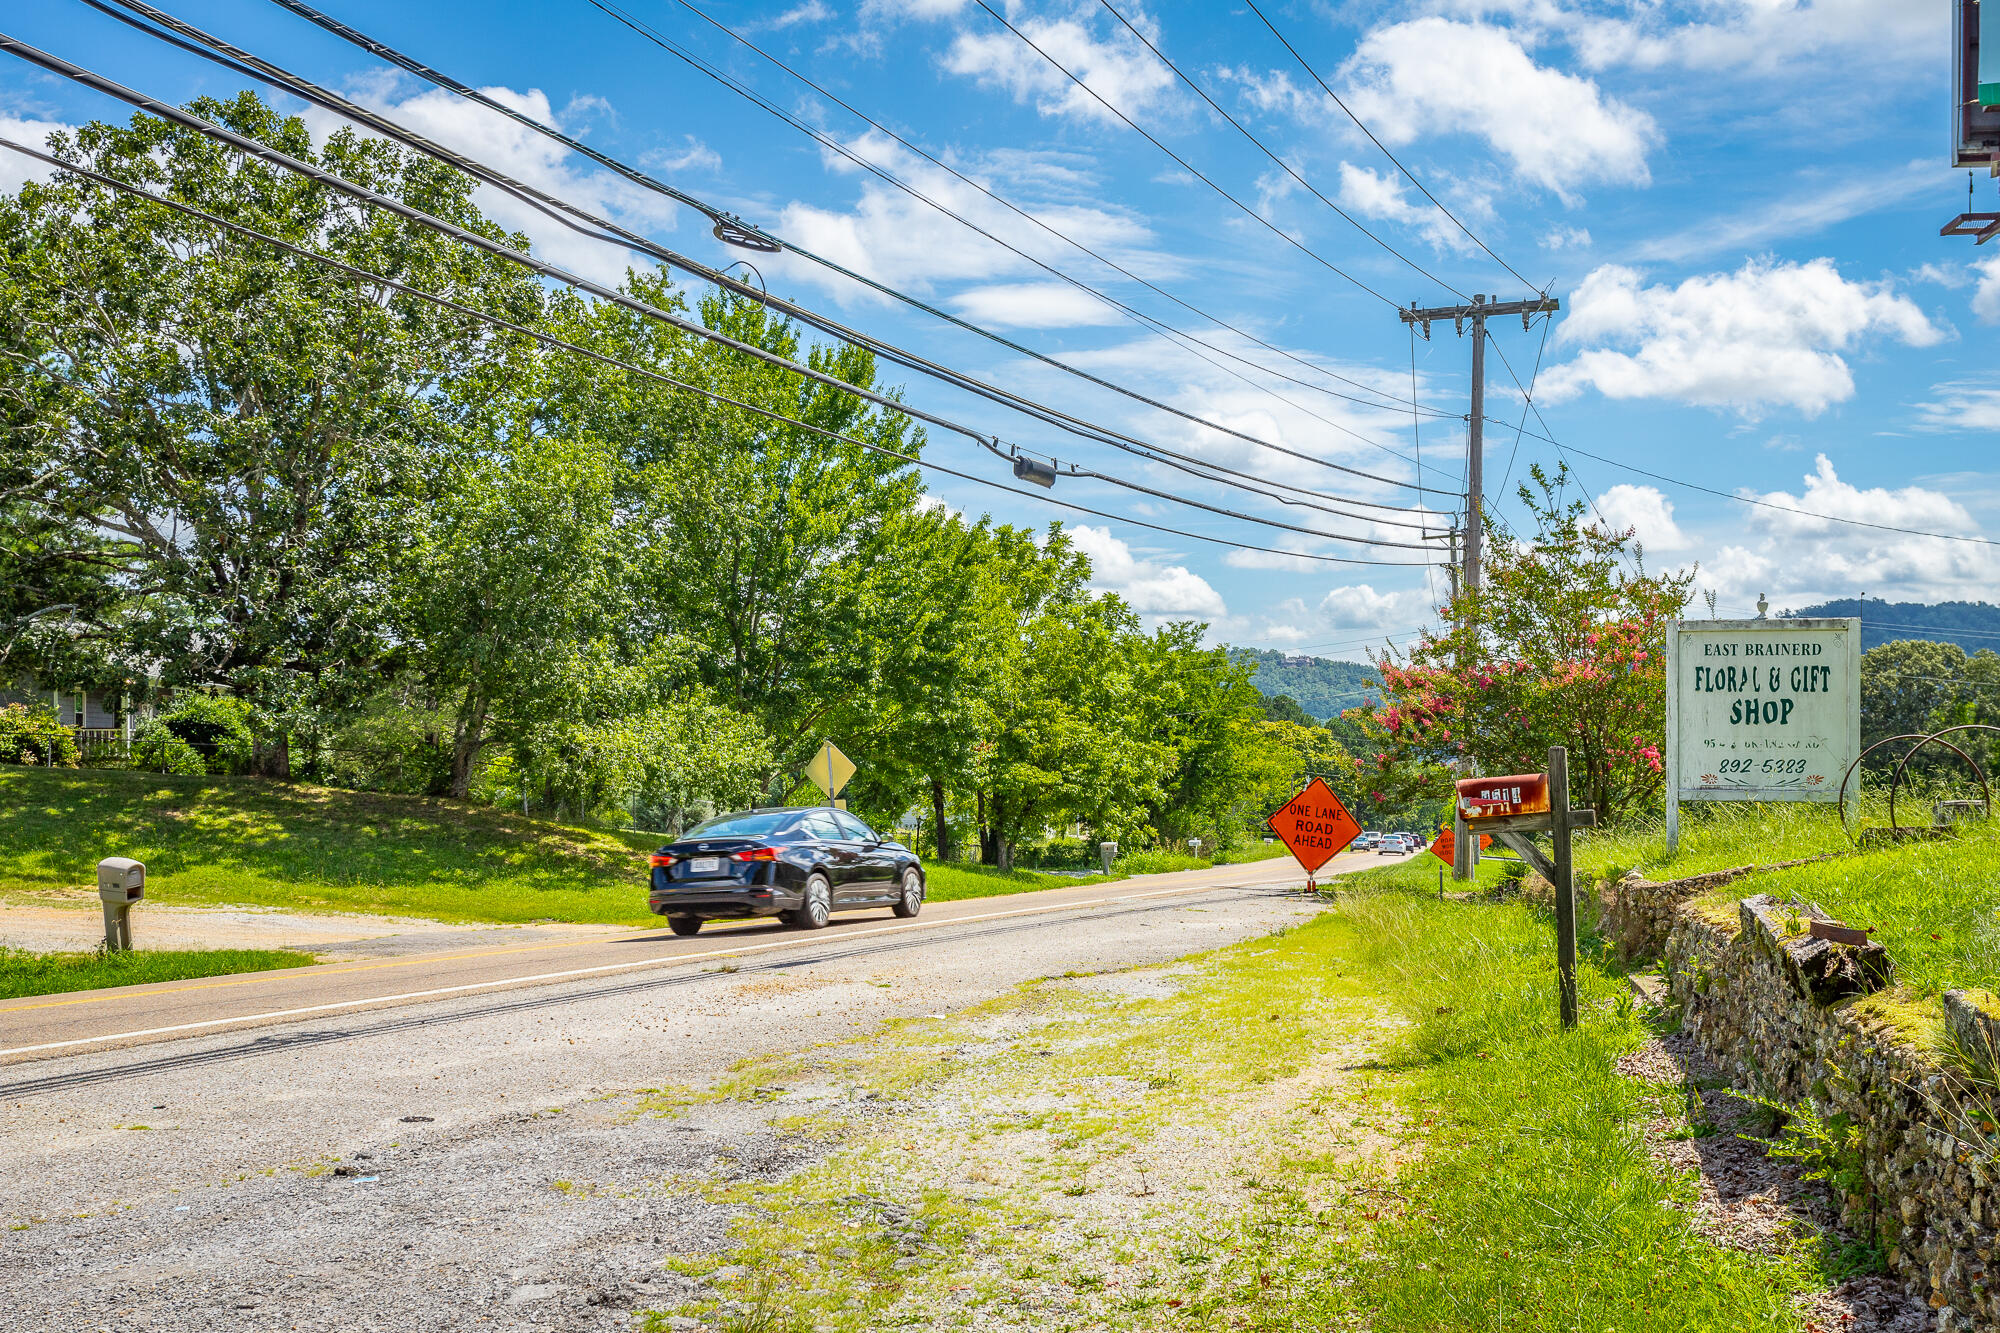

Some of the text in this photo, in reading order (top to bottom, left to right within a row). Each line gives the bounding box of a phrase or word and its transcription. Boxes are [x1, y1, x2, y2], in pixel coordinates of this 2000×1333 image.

[1704, 643, 1822, 657] EAST BRAINERD
[1695, 665, 1831, 693] FLORAL & GIFT
[1730, 697, 1795, 725] SHOP
[1718, 758, 1807, 774] 892-5383
[1289, 803, 1343, 821] ONE LANE
[1295, 819, 1334, 835] ROAD
[1293, 833, 1332, 849] AHEAD
